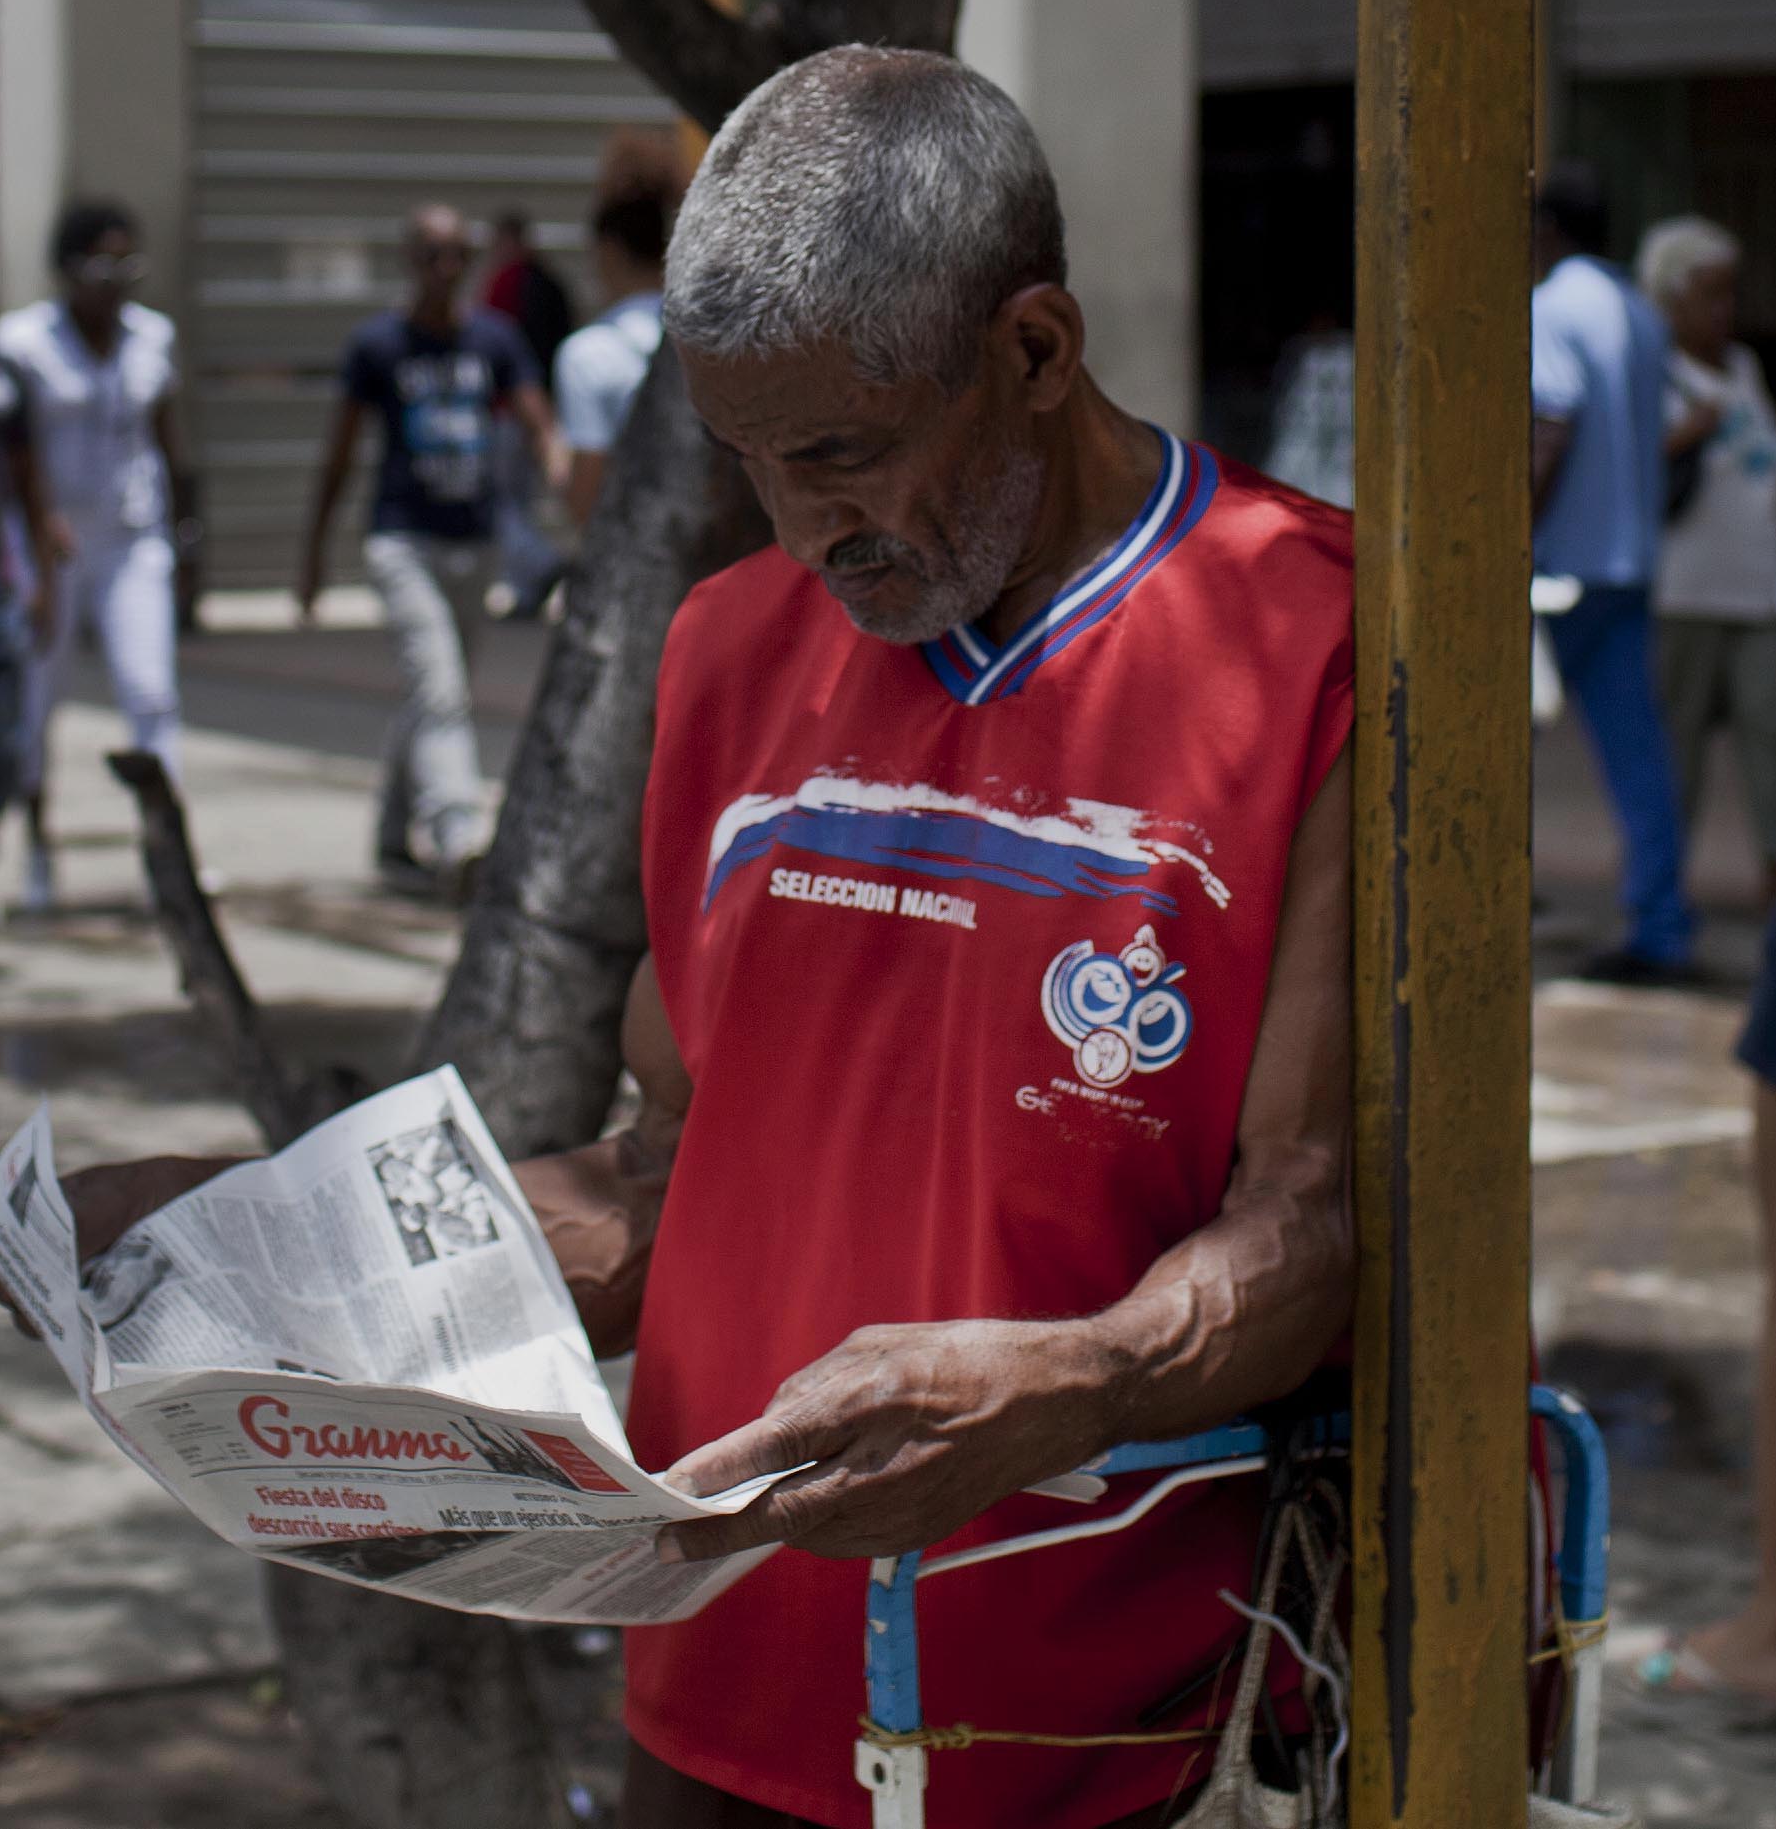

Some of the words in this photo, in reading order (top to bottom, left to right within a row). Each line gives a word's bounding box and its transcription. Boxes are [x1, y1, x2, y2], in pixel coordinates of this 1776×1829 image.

[769, 868, 897, 914] SELECCION
[237, 1395, 473, 1461] Granma
[254, 1485, 312, 1508] Fiesta
[312, 1486, 341, 1509] del
[341, 1486, 388, 1511] disco
[438, 1505, 471, 1528] Más
[471, 1509, 497, 1530] que
